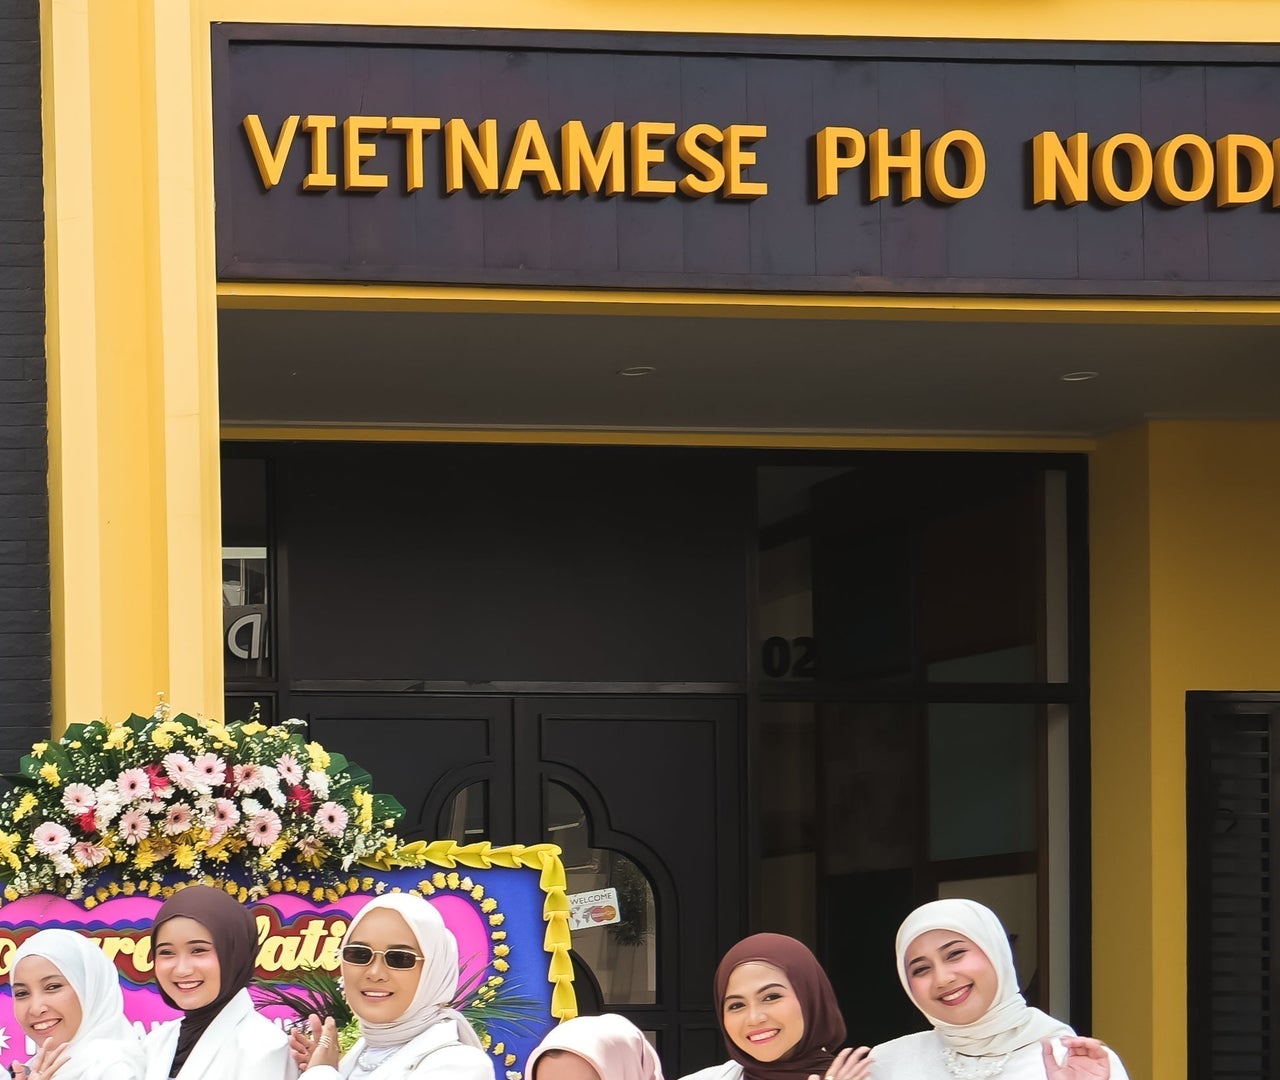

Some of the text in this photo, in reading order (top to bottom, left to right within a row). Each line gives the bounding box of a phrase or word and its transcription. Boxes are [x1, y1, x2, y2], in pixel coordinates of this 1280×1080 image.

[242, 114, 1280, 209] VIETNAMESE PHO NOOD
[761, 636, 817, 678] 02
[569, 892, 613, 905] WELCOME
